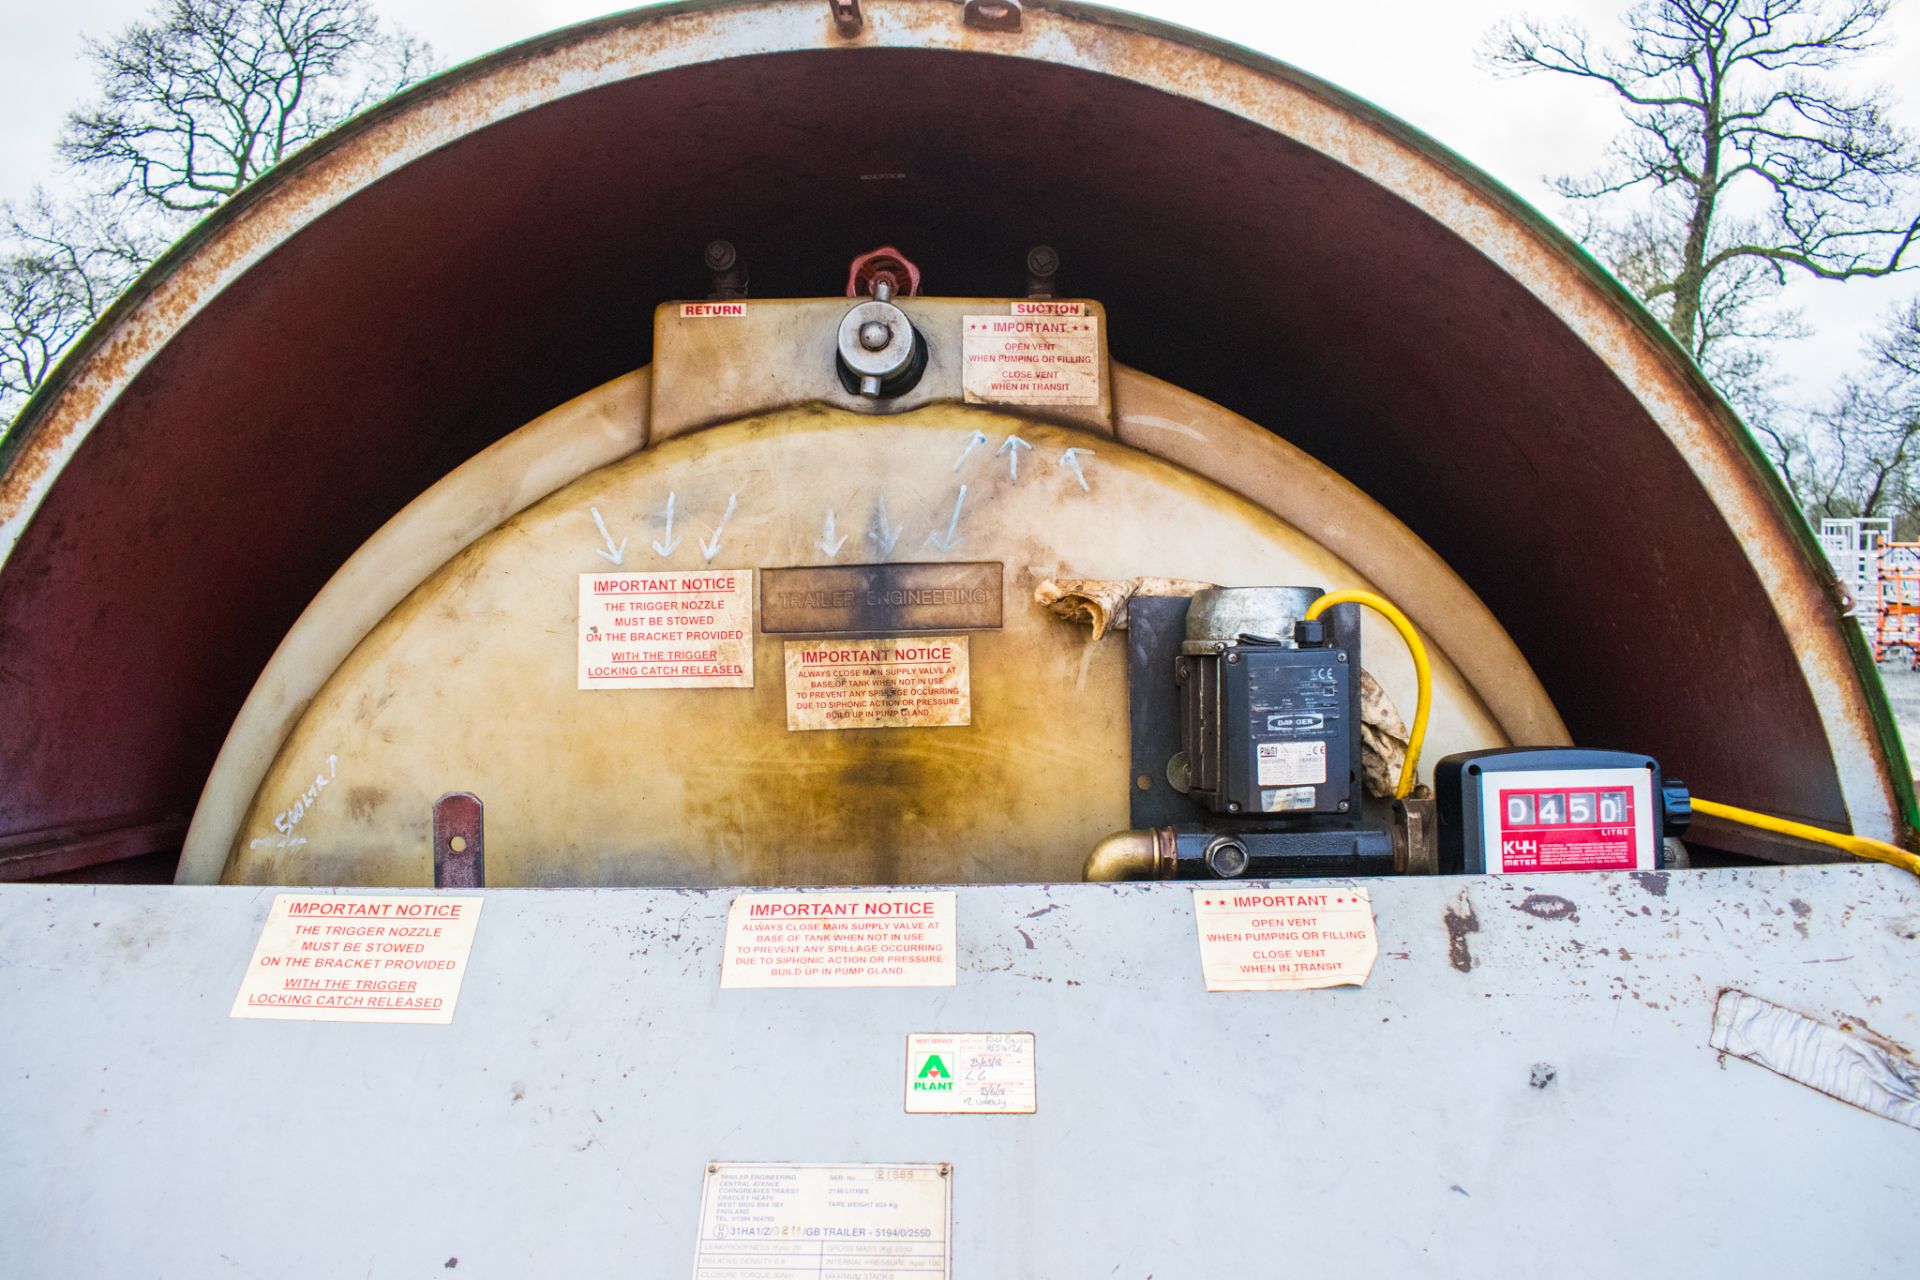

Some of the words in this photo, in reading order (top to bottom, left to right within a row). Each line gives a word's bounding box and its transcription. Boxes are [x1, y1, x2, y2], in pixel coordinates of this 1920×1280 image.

[685, 305, 741, 316] RETURN
[1018, 305, 1082, 314] SUCTION
[994, 322, 1067, 333] IMPORTANT
[1005, 343, 1030, 351] OPEN
[1032, 343, 1056, 351] VENT
[970, 355, 995, 363] WHEN
[998, 355, 1039, 364] PUMPING
[1041, 355, 1055, 364] OR
[1056, 355, 1092, 364] FILLING
[1002, 370, 1032, 379] CLOSE
[1034, 370, 1057, 379] VENT
[991, 382, 1018, 391] WHEN
[1020, 383, 1029, 391] IN
[1032, 383, 1069, 392] TRANSIT
[594, 580, 677, 592] IMPORTANT
[681, 578, 735, 590] NOTICE
[779, 591, 855, 608] TRAILER
[867, 588, 986, 605] ENGINEERING
[606, 602, 624, 611] THE
[630, 601, 678, 611] TRIGGER
[681, 601, 724, 610] NOZZLE
[615, 617, 643, 626] MUST
[648, 617, 662, 626] BE
[666, 616, 714, 626] STOWED
[586, 633, 601, 642] ON
[607, 633, 625, 642] THE
[630, 632, 683, 641] BRACKET
[686, 631, 743, 640] PROVIDED
[612, 652, 639, 661] WITH
[644, 652, 663, 660] THE
[669, 651, 717, 660] TRIGGER
[802, 649, 889, 663] IMPORTANT
[895, 648, 950, 661] NOTICE
[588, 667, 637, 676] LOCKING
[641, 666, 678, 675] CATCH
[681, 665, 742, 675] RELEASED
[798, 670, 831, 678] ALWAYS
[833, 669, 861, 677] CLOSE
[886, 668, 916, 676] SUPPLY
[946, 667, 955, 675] AT
[811, 680, 834, 688] BASE
[848, 679, 870, 687] TANK
[809, 691, 846, 699] PREVENT
[848, 690, 865, 698] ANY
[910, 688, 958, 696] OCCURRING
[816, 701, 826, 709] TO
[829, 700, 866, 709] SIPHONIC
[870, 700, 900, 708] ACTION
[902, 699, 914, 707] OR
[916, 698, 958, 706] PRESSURE
[826, 711, 850, 719] BUILD
[1504, 840, 1537, 854] K44
[1234, 896, 1328, 907] IMPORTANT
[288, 903, 389, 916] IMPORTANT
[395, 904, 461, 917] NOTICE
[750, 903, 859, 916] IMPORTANT
[865, 902, 933, 915] NOTICE
[823, 923, 848, 931] MAIN
[928, 922, 938, 930] AT
[1252, 919, 1284, 928] OPEN
[1287, 918, 1316, 927] VENT
[295, 926, 321, 935] THE
[325, 926, 385, 936] TRIGGER
[388, 927, 442, 937] NOZZLE
[1207, 933, 1241, 942] WHEN
[1245, 932, 1298, 941] PUMPING
[1302, 932, 1319, 940] OR
[1322, 931, 1366, 940] FILLING
[805, 934, 831, 942] TANK
[833, 934, 864, 942] WHEN
[300, 942, 338, 952] MUST
[342, 942, 361, 952] BE
[365, 943, 425, 953] STOWED
[753, 946, 799, 954] PREVENT
[827, 945, 877, 953] SPILLAGE
[880, 944, 942, 952] OCCURRING
[1253, 950, 1292, 959] CLOSE
[1296, 950, 1324, 958] VENT
[259, 957, 281, 967] ON
[285, 957, 311, 967] THE
[314, 958, 380, 969] BRACKET
[384, 959, 456, 970] PROVIDED
[736, 957, 756, 965] DUE
[828, 956, 866, 964] ACTION
[887, 955, 944, 963] PRESSURE
[804, 968, 818, 976] UP
[821, 968, 831, 976] IN
[1240, 964, 1275, 973] WHEN
[1279, 964, 1290, 972] IN
[1294, 963, 1341, 972] TRANSIT
[284, 978, 320, 989] WITH
[324, 979, 350, 989] THE
[355, 980, 417, 991] TRIGGER
[248, 994, 312, 1005] LOCKING
[315, 995, 364, 1006] CATCH
[366, 997, 443, 1008] RELEASED
[914, 1082, 953, 1091] PLANT
[824, 1227, 866, 1237] TRAILER
